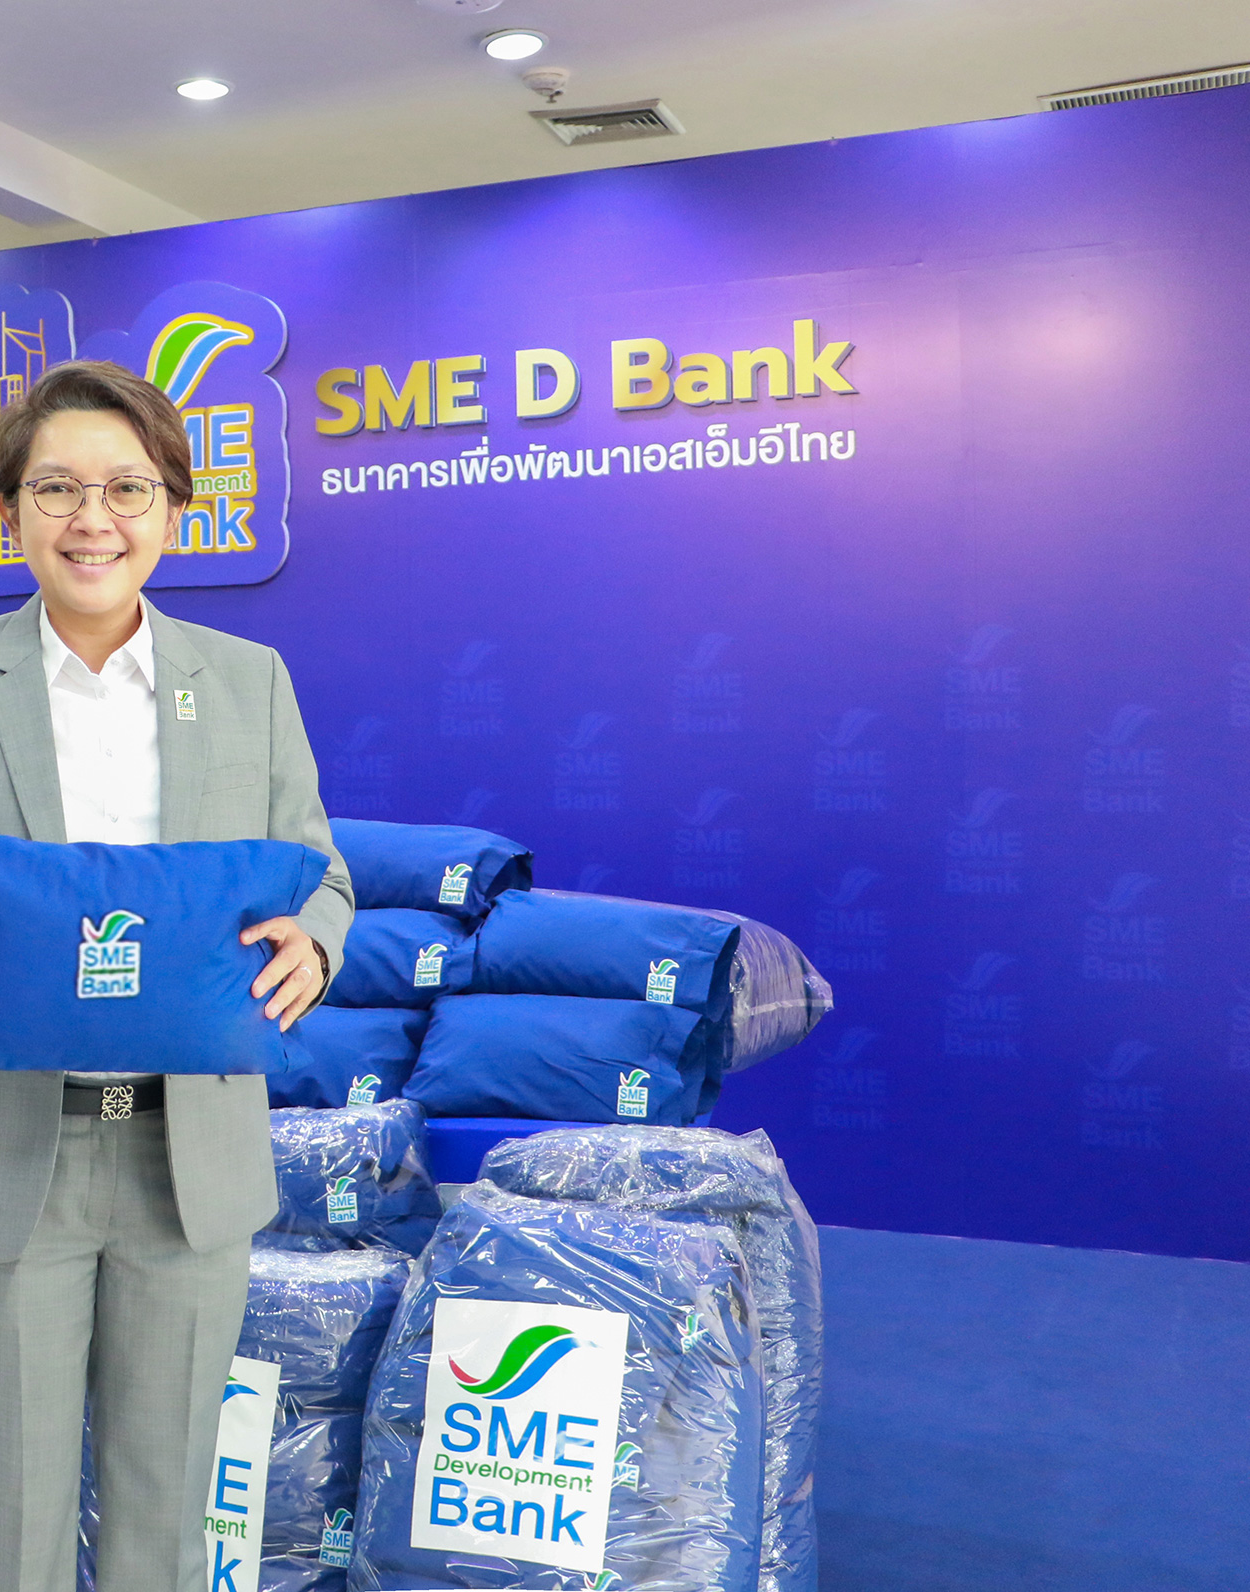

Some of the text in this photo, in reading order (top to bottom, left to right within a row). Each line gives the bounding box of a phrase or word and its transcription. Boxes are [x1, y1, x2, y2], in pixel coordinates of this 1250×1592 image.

[314, 318, 860, 438] SME D Bank
[322, 422, 855, 496] ธนาคารเพื่อพัฒนาเอสเอ็มอีไทย
[166, 495, 253, 550] nk
[443, 878, 466, 889] SME
[440, 893, 463, 903] Bank
[84, 945, 136, 967] SME
[418, 959, 440, 971] SME
[81, 977, 135, 995] Bank
[416, 974, 439, 985] Bank
[650, 975, 675, 988] SME
[648, 992, 672, 1003] Bank
[350, 1091, 373, 1103] SME
[620, 1088, 646, 1101] SME
[619, 1105, 644, 1116] Bank
[329, 1194, 354, 1207] SME
[330, 1210, 356, 1222] Bank
[441, 1402, 599, 1470] SME
[433, 1453, 593, 1493] Development
[614, 1465, 637, 1481] ME
[429, 1476, 588, 1547] Bank
[323, 1531, 350, 1547] SME
[321, 1552, 349, 1567] Bank
